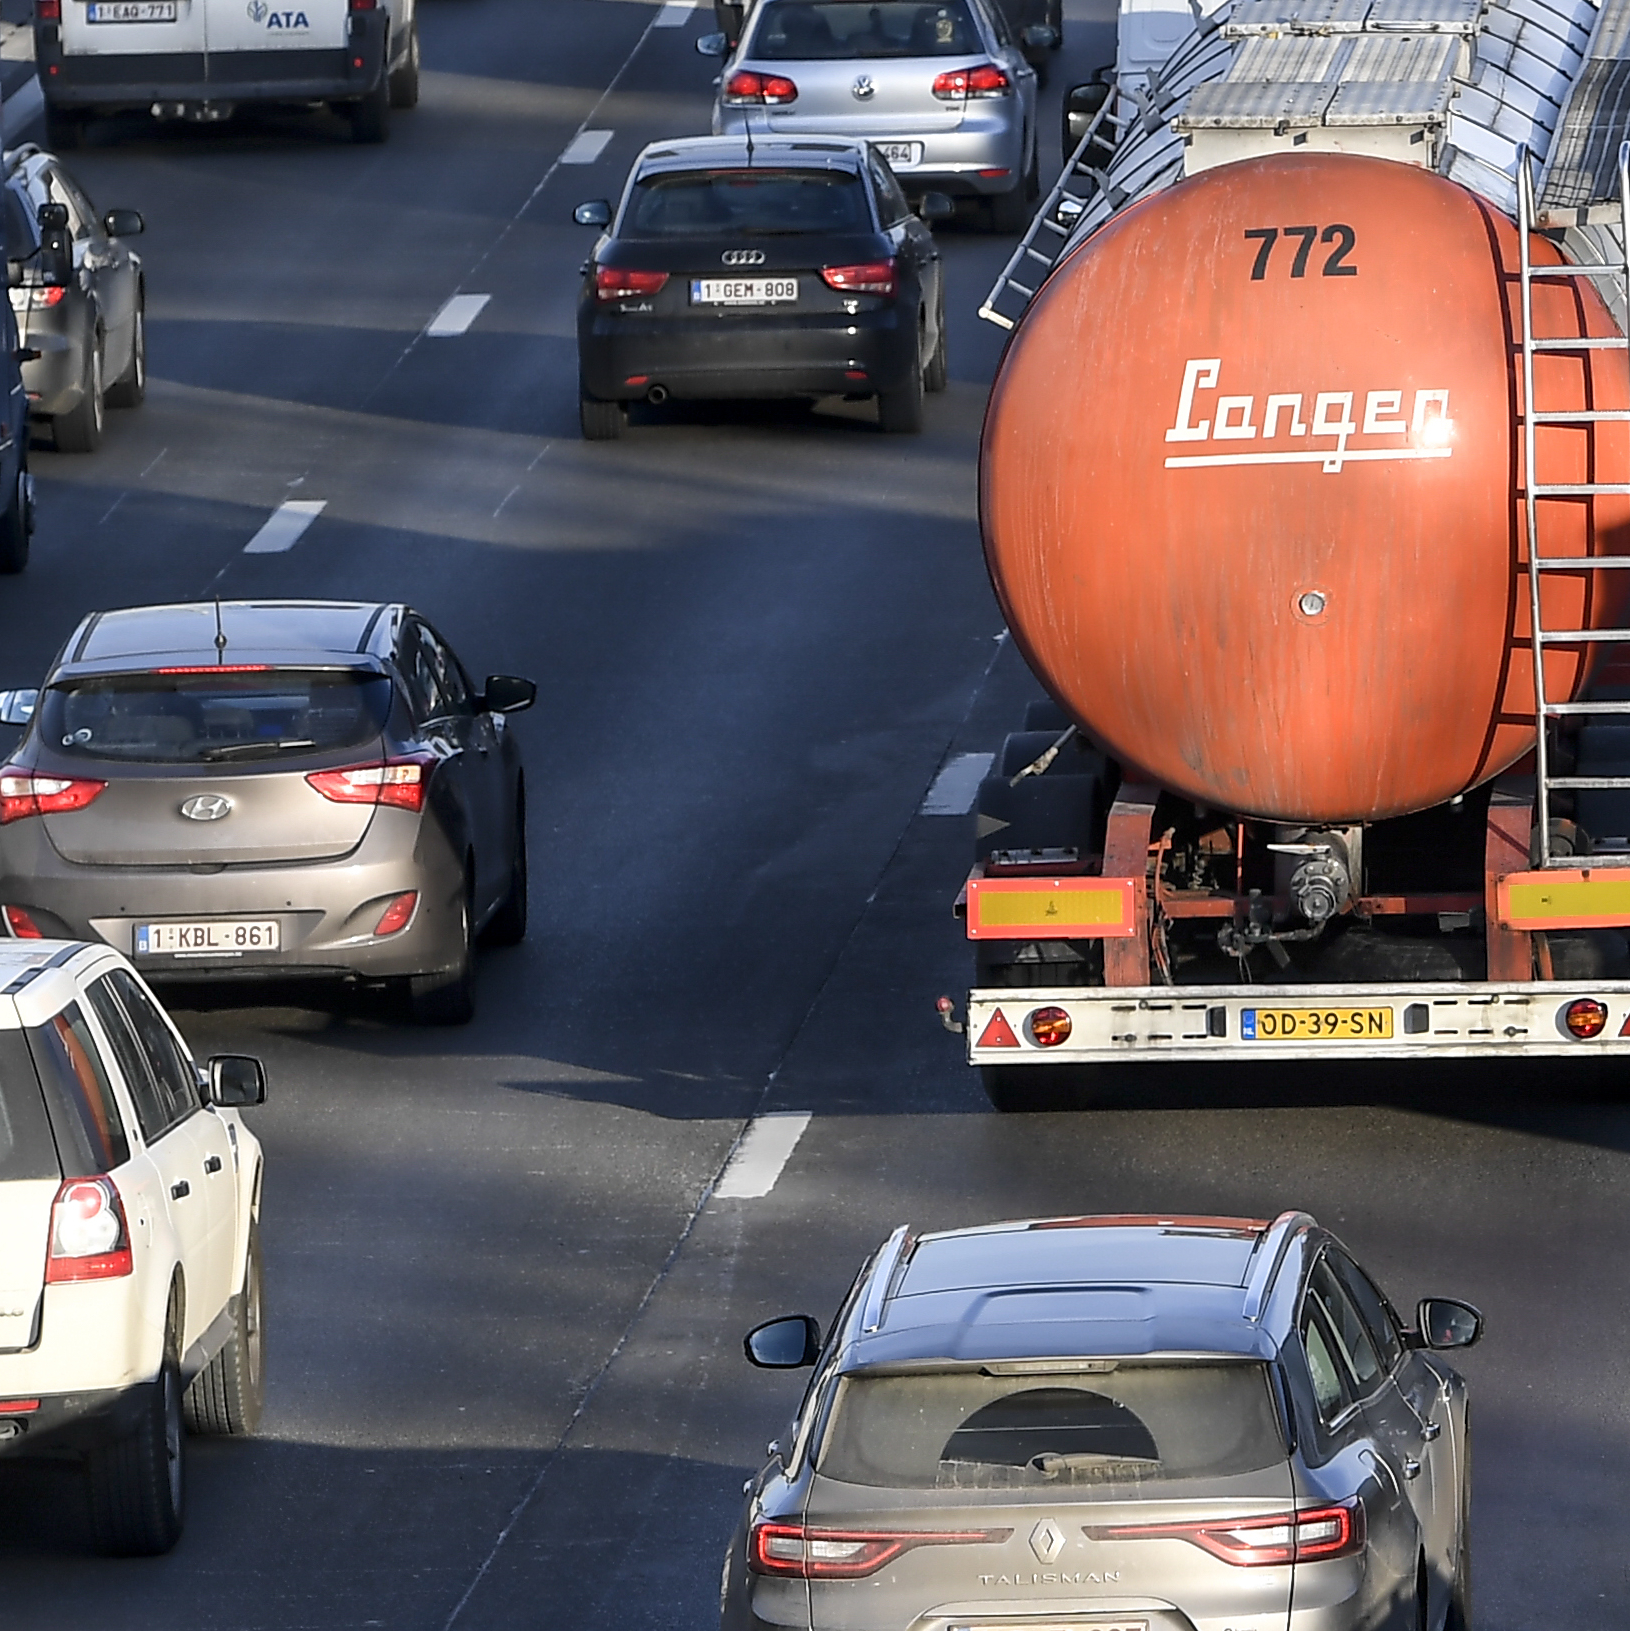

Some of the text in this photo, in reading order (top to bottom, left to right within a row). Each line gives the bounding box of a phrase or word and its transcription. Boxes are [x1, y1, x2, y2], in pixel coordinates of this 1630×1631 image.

[266, 11, 310, 29] ATA
[1244, 223, 1358, 281] 772
[1164, 357, 1453, 474] Langen
[977, 1571, 1120, 1586] TALISMAN
